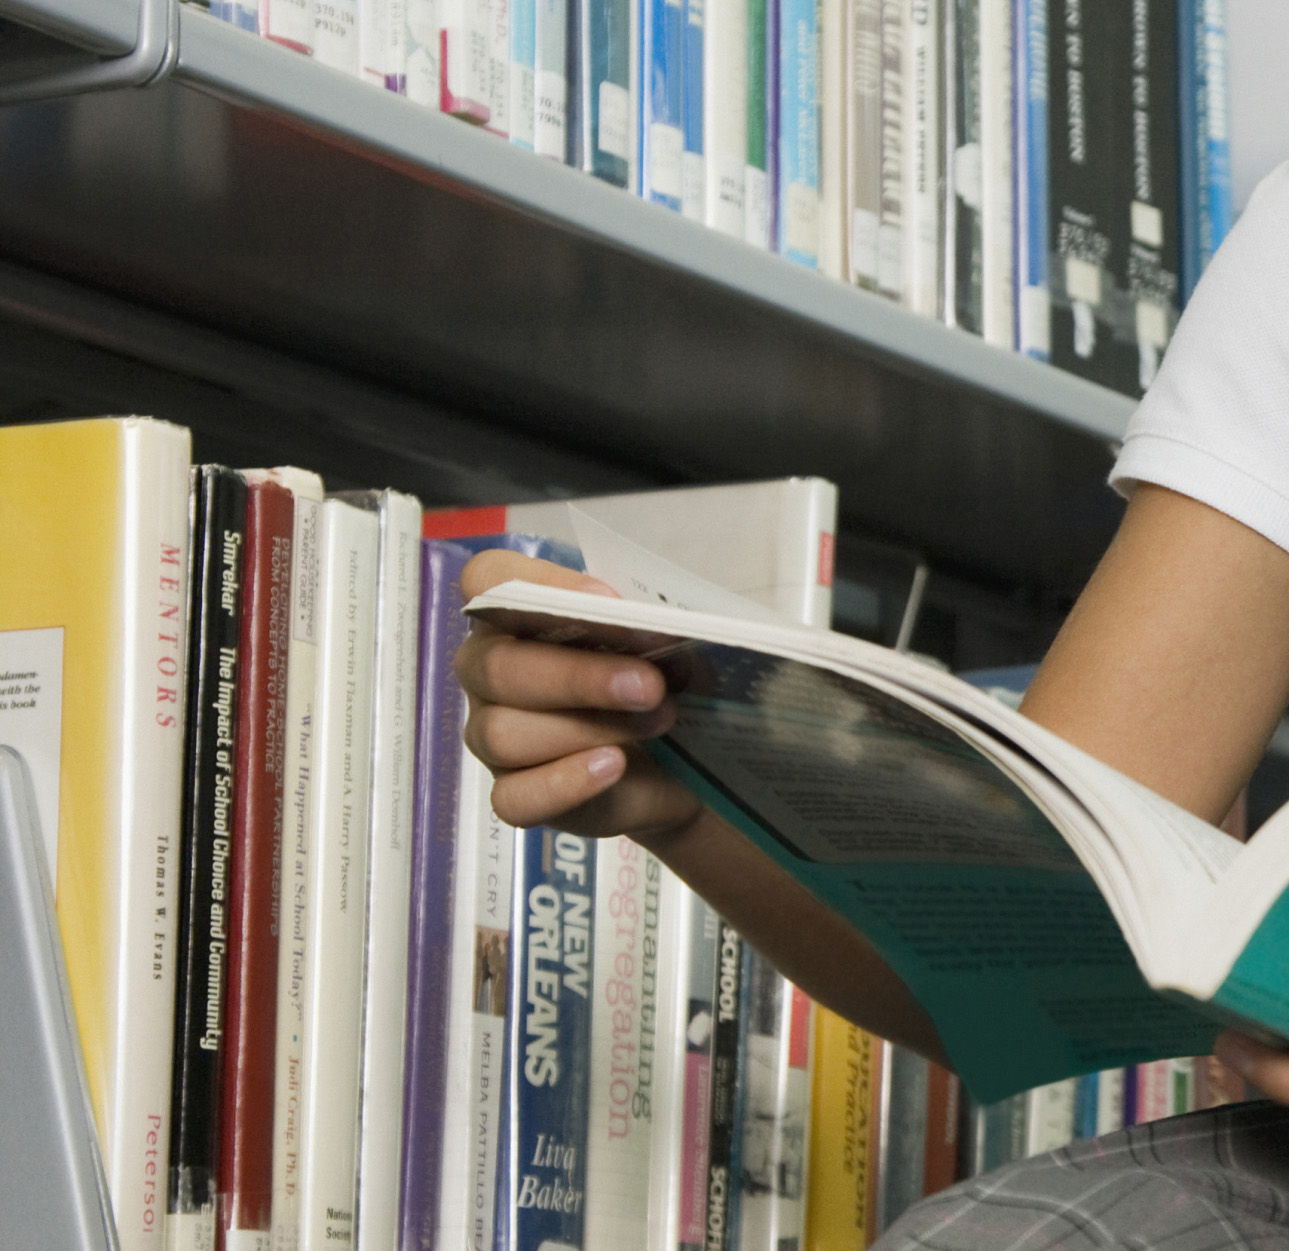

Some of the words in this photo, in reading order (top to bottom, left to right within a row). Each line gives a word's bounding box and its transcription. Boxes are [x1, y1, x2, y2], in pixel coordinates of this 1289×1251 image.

[1066, 34, 1082, 65] TO
[1066, 70, 1086, 162] BOSTON
[1132, 76, 1149, 108] TO
[220, 530, 241, 615] Smrekar
[270, 536, 280, 582] FROM
[347, 550, 359, 600] Edited
[397, 531, 408, 582] Richard
[278, 537, 290, 649] DEVELOPING
[345, 604, 358, 623] by
[155, 543, 181, 729] MENTORS
[268, 586, 280, 669] CONCEPTS
[346, 629, 357, 675] Erwin
[24, 684, 40, 694] the
[218, 647, 237, 678] The
[267, 675, 278, 694] TO
[10, 698, 36, 710] book
[212, 680, 236, 746] Impact
[274, 655, 287, 793] HOME-SCHOOL
[344, 681, 356, 747] Flaxman
[394, 687, 405, 711] and
[215, 750, 234, 771] of
[265, 698, 277, 774] PRACTICE
[391, 735, 404, 786] William
[343, 752, 355, 782] and
[213, 774, 232, 836] School
[294, 766, 310, 854] Happened
[339, 804, 352, 849] Harry
[487, 810, 499, 864] ON'T
[555, 831, 588, 887] OF
[155, 835, 169, 898] Thomas
[211, 838, 230, 900] Choice
[270, 796, 283, 937] PARTNERSHIPS
[294, 860, 306, 877] at
[339, 854, 351, 914] Passow
[155, 906, 167, 924] W.
[209, 903, 228, 938] and
[293, 883, 306, 942] School
[486, 873, 498, 918] CRY
[153, 932, 166, 981] Evans
[562, 891, 591, 999] NEW
[200, 941, 224, 1051] Community
[524, 884, 561, 1088] ORLEANS
[631, 856, 661, 1124] smantling
[718, 927, 738, 1023] SCHOOL
[288, 1055, 300, 1092] Judi
[480, 1032, 491, 1103] MELBA
[844, 1061, 859, 1175] Practice
[476, 1111, 488, 1209] PATTILLO
[516, 1173, 583, 1214] Baker
